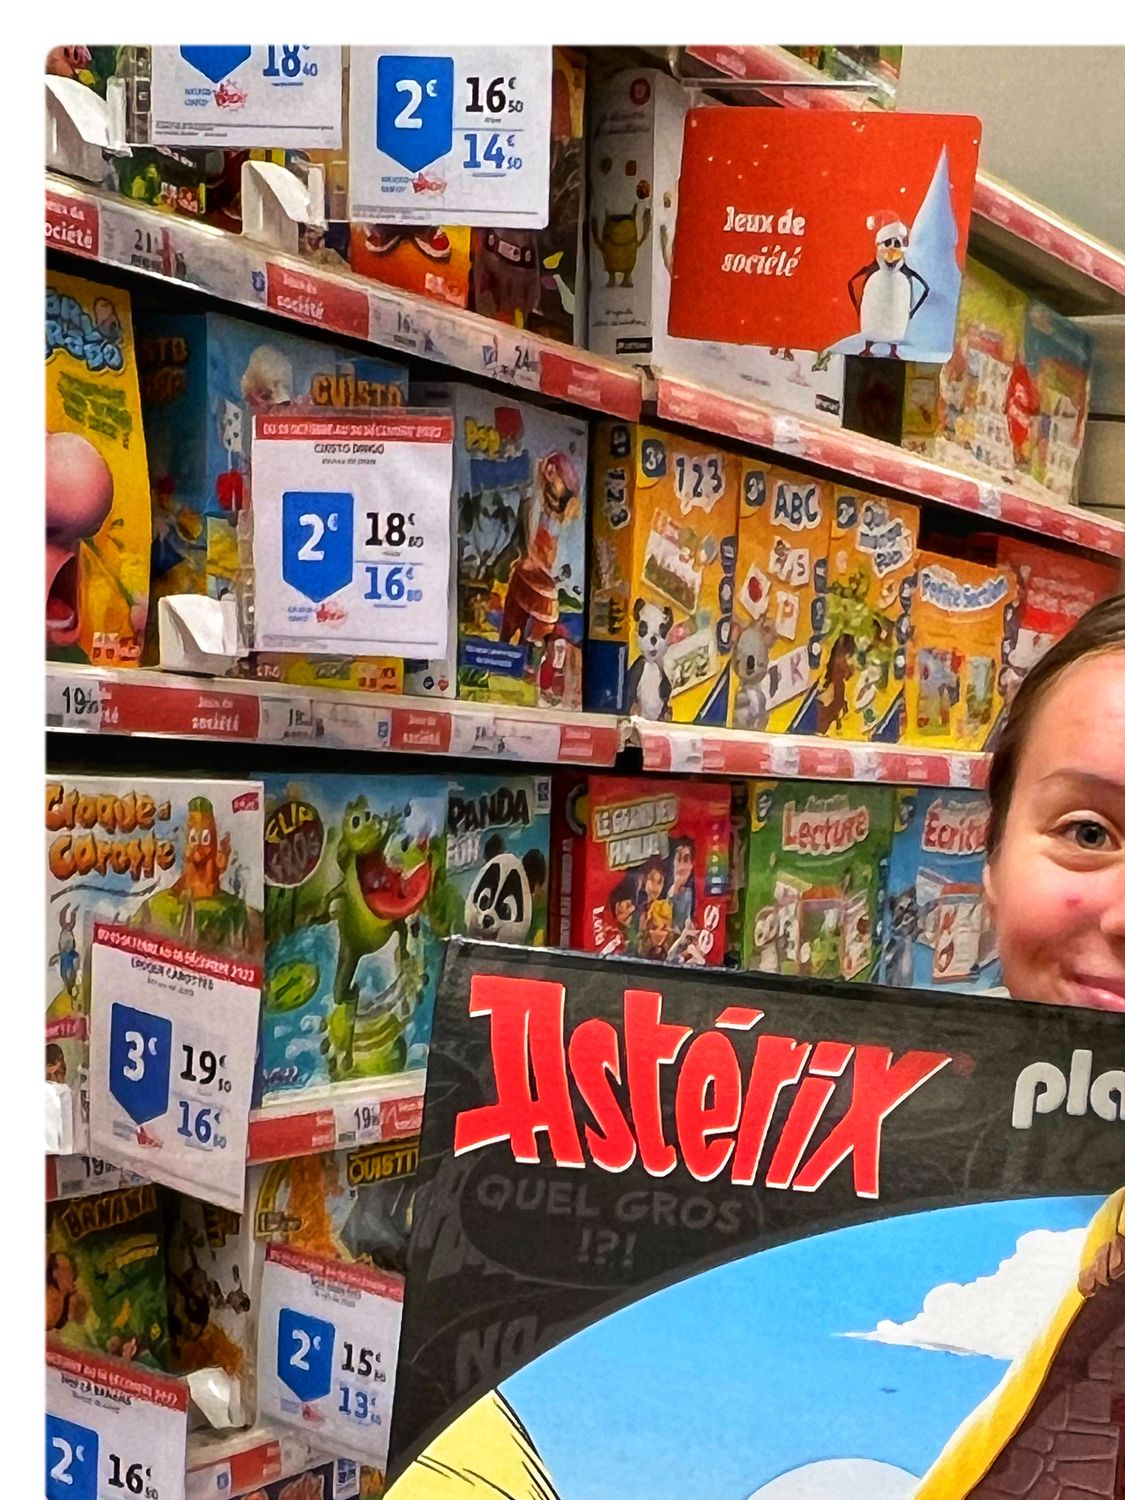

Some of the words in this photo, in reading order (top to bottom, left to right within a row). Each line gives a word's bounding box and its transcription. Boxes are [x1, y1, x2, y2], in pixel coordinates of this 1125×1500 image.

[723, 206, 772, 234] Jeux
[777, 208, 806, 237] de
[721, 245, 801, 278] société
[775, 483, 818, 525] ABC
[785, 808, 868, 849] Lecture
[454, 974, 953, 1198] Astérix
[476, 1174, 600, 1216] QUEL
[615, 1190, 744, 1236] GROS
